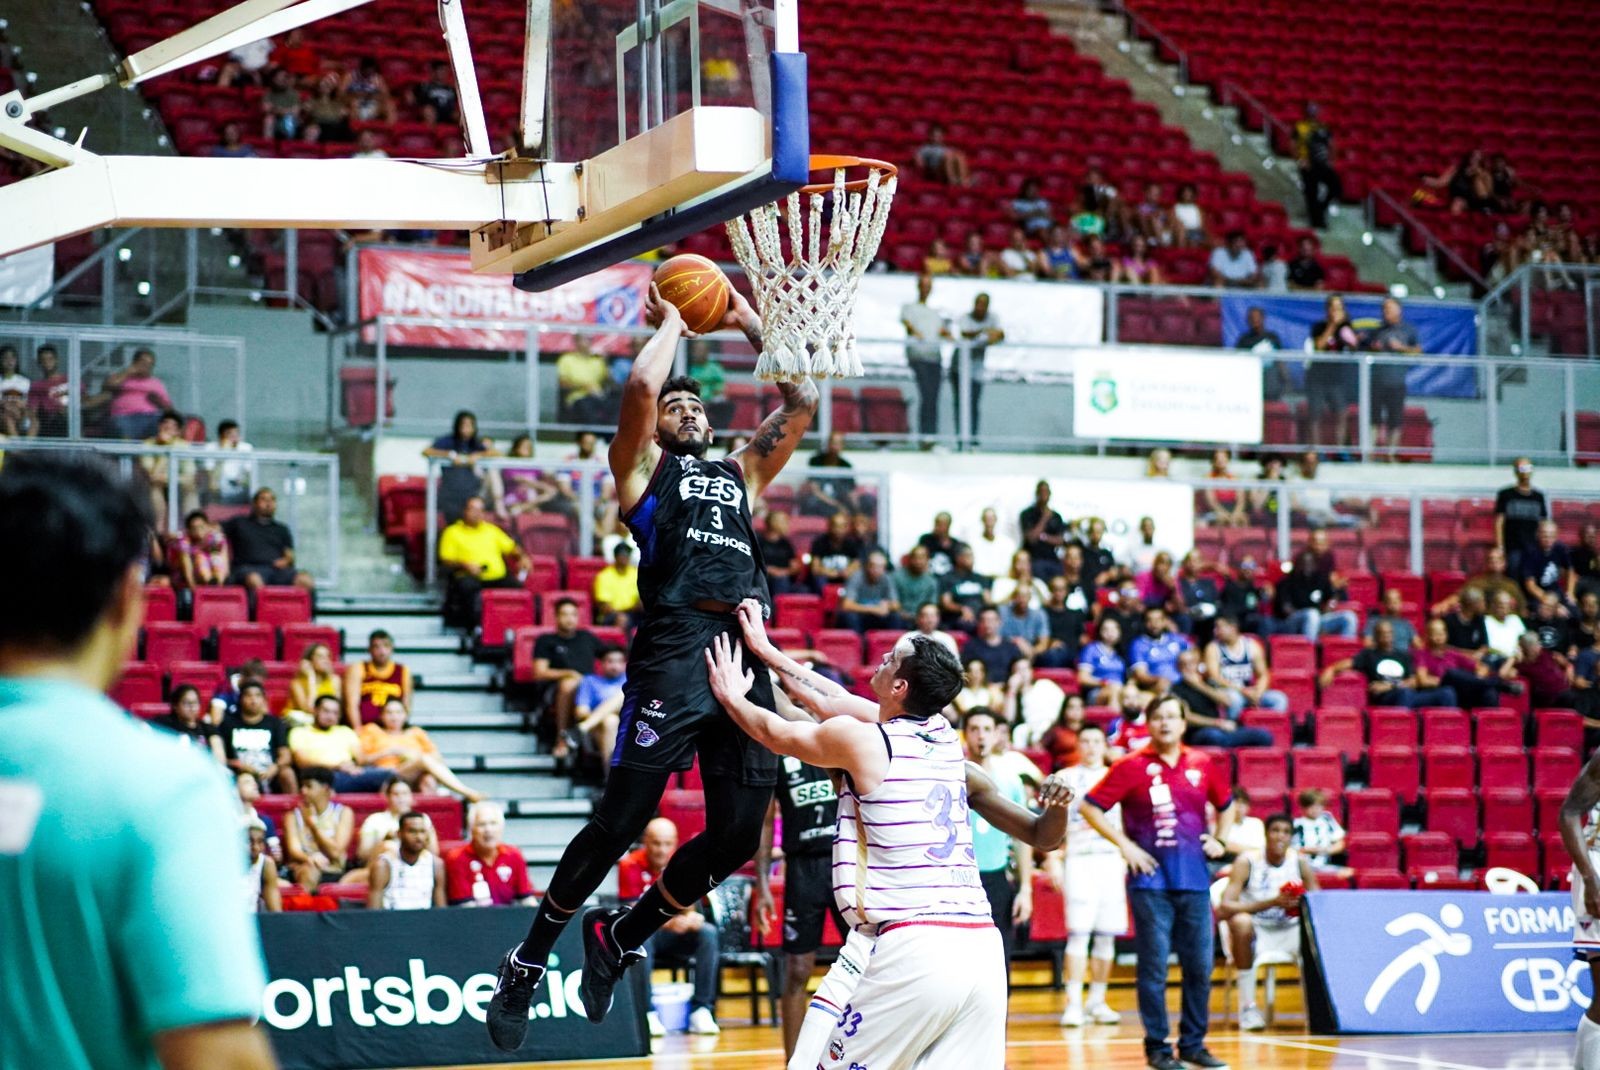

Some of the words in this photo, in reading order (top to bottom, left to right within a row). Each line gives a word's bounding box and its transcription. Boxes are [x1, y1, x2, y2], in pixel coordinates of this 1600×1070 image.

[688, 478, 740, 504] SES
[710, 505, 724, 530] 3
[797, 782, 836, 803] SES
[837, 1003, 863, 1037] 33
